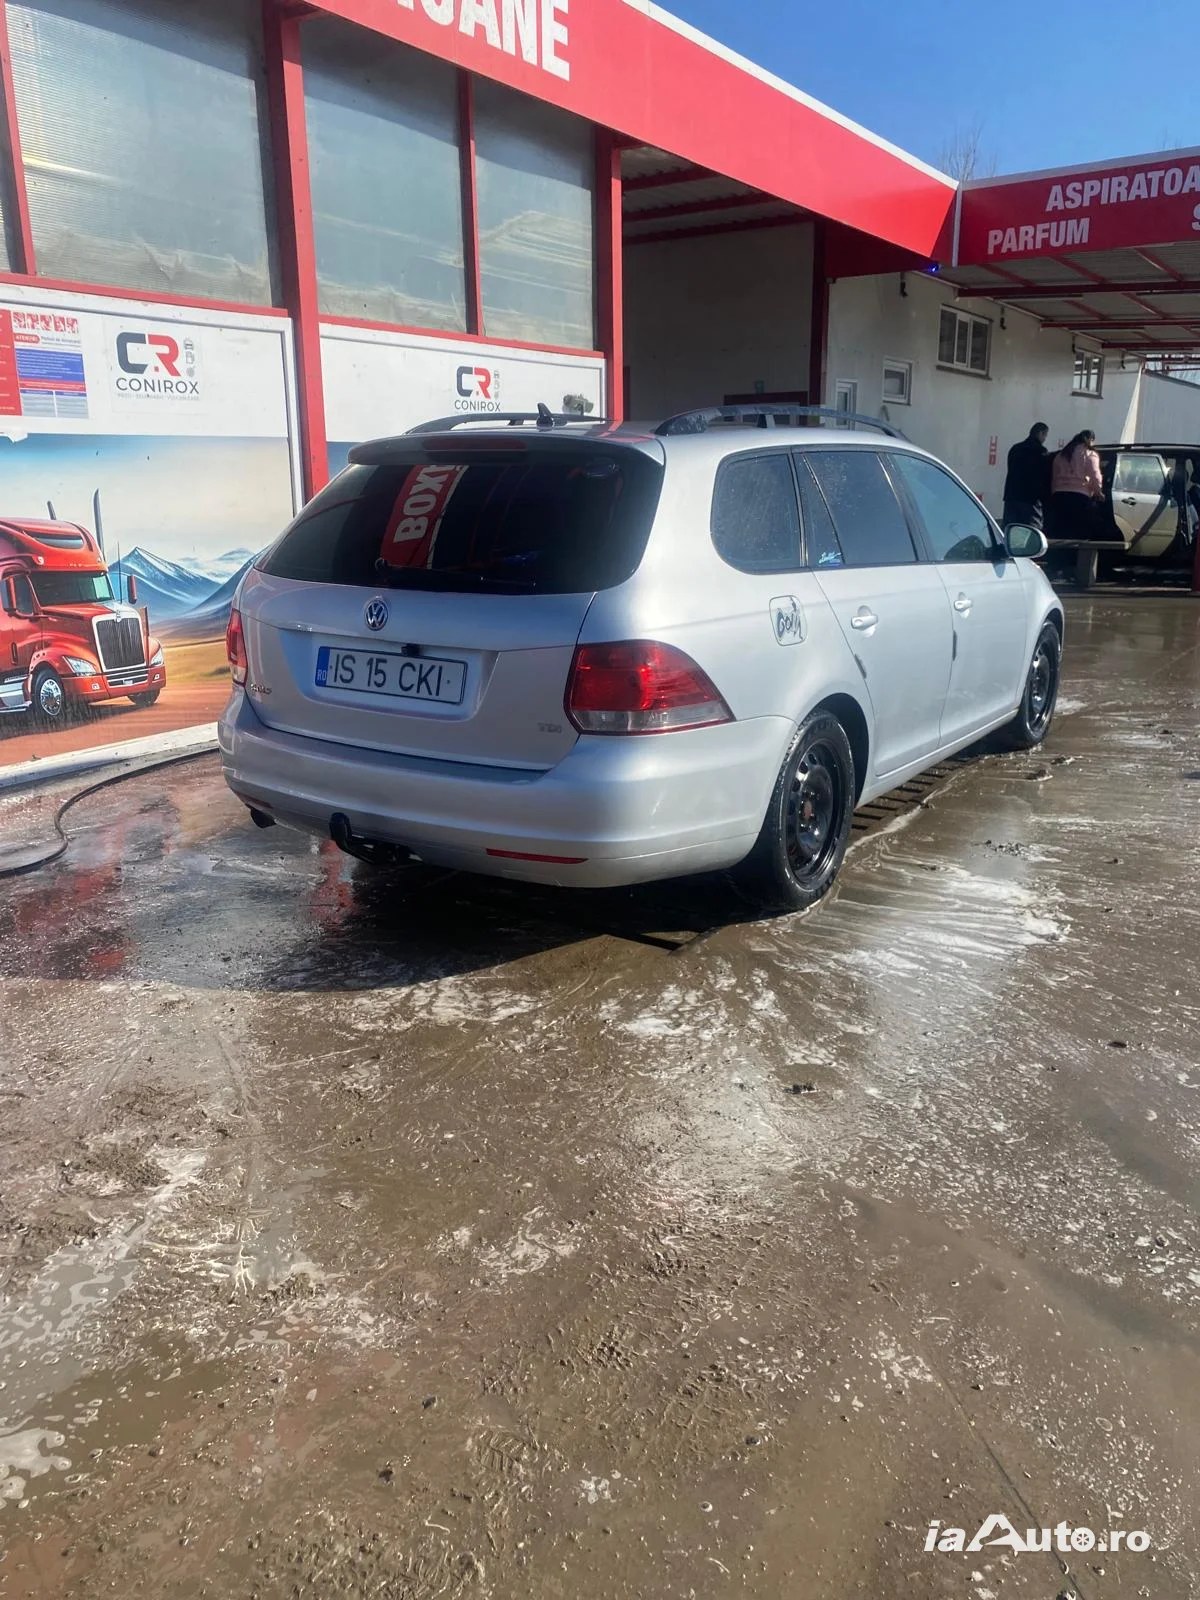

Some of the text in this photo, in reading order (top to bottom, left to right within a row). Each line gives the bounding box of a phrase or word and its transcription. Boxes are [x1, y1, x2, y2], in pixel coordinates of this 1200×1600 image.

[987, 217, 1090, 255] PARFUM
[116, 377, 200, 394] CONIROX
[454, 400, 501, 412] CONIROX
[333, 654, 443, 696] IS 15 CKI
